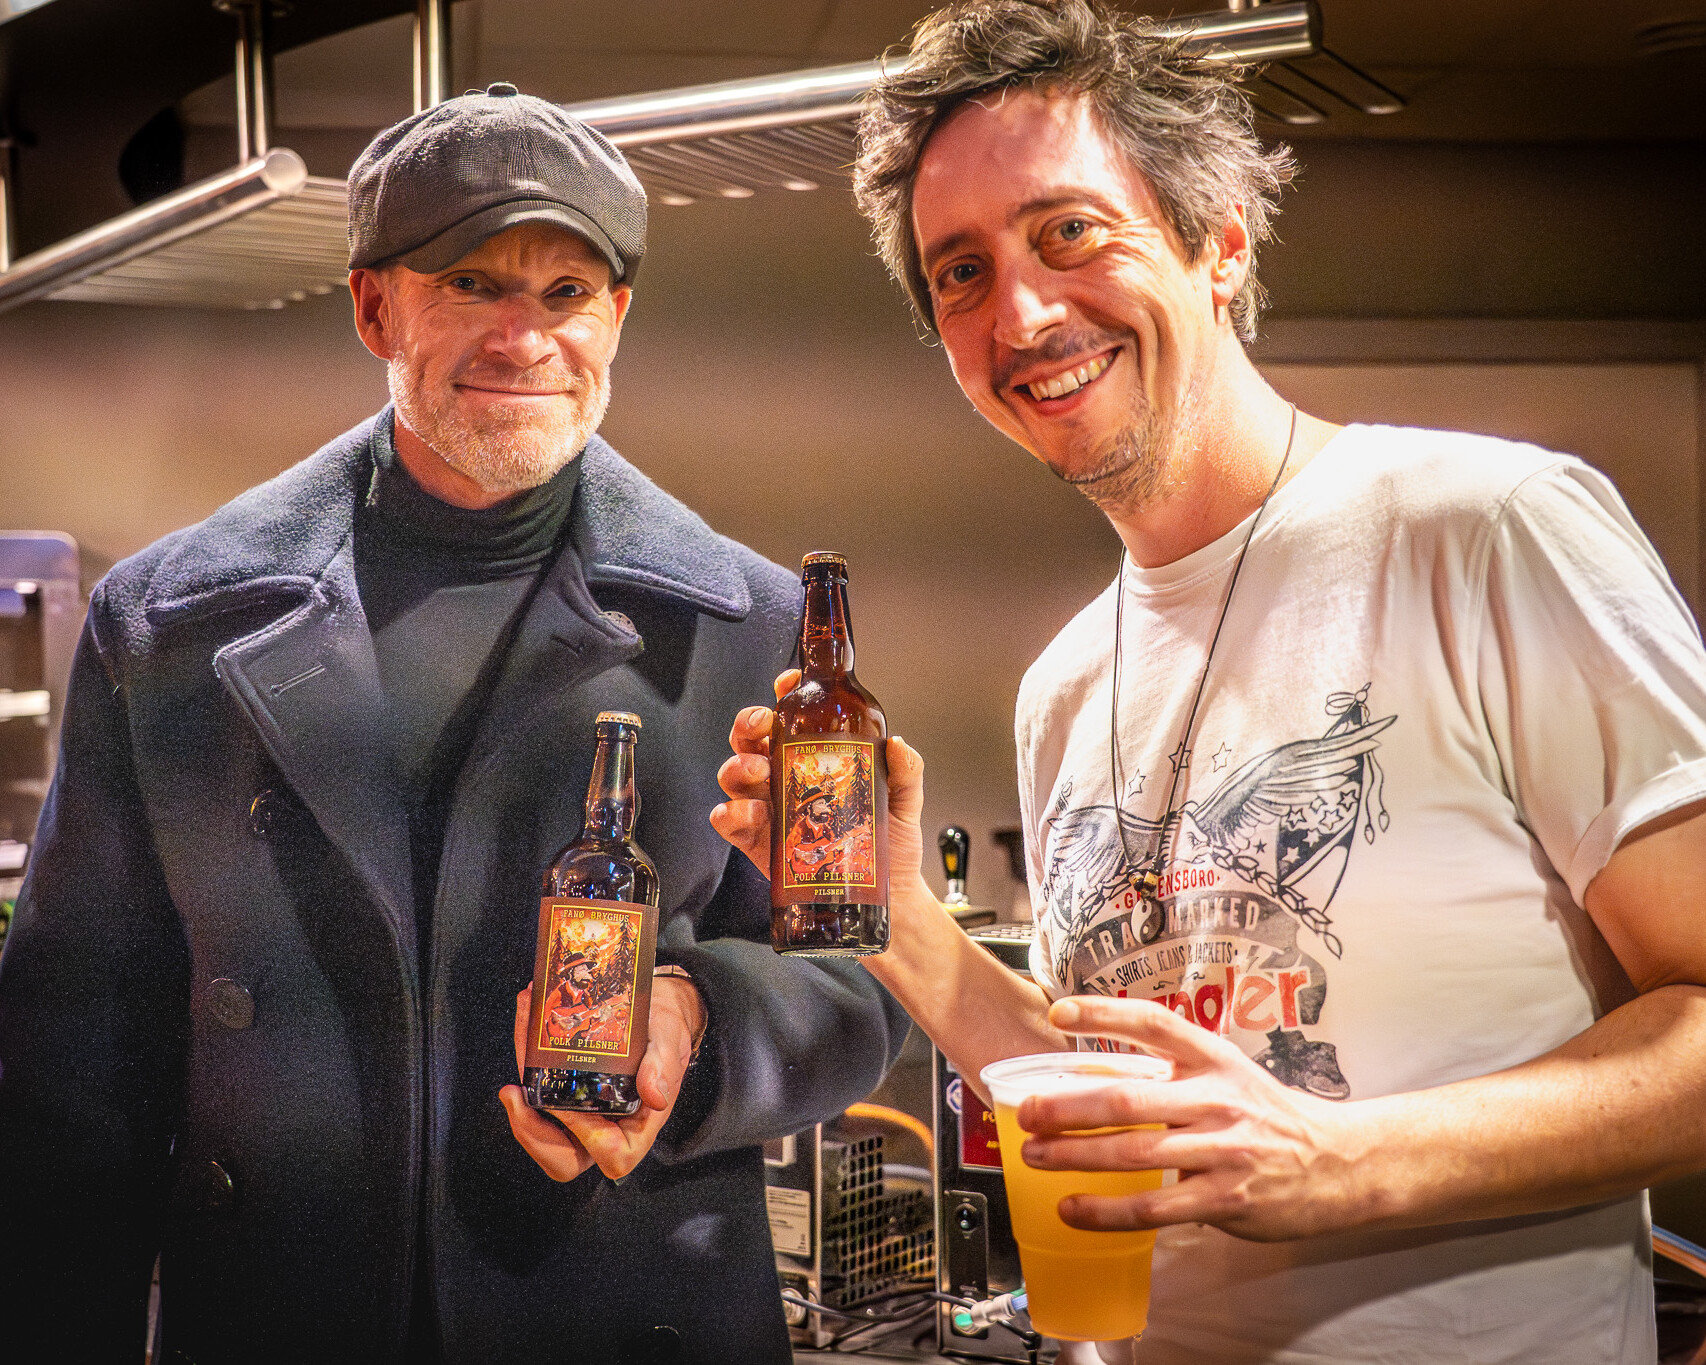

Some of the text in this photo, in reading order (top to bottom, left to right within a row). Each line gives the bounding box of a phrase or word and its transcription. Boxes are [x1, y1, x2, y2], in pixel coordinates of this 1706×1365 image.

[794, 744, 862, 754] FANØ BRYGHUS
[794, 871, 865, 882] FOLK PILSNER
[814, 888, 845, 896] PILSNER
[1124, 869, 1215, 909] GENSBORO
[562, 909, 630, 923] FANØ BRYGHUS
[1083, 897, 1261, 966] TRAMARKED
[1157, 947, 1187, 972] JEANS
[1193, 941, 1233, 964] JACKETS
[549, 1036, 619, 1051] FOLK PILSNER
[566, 1054, 597, 1064] PILSNER
